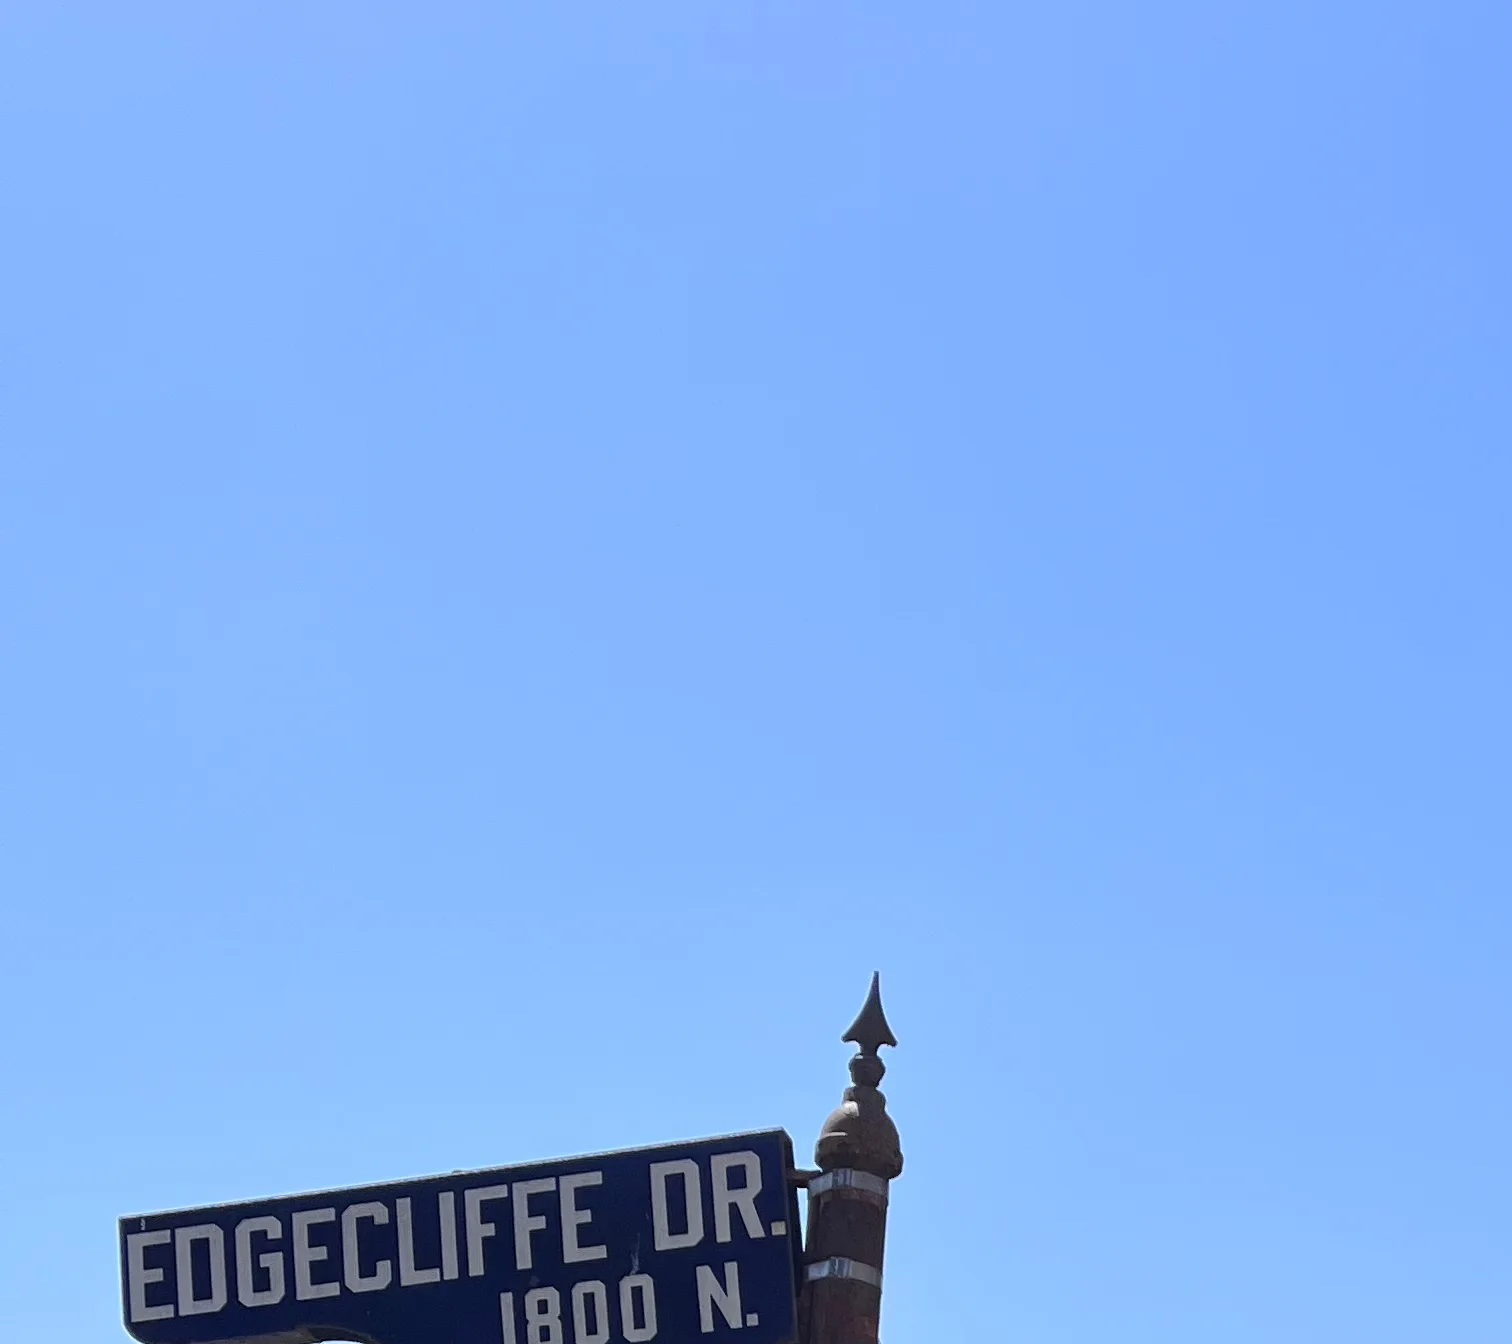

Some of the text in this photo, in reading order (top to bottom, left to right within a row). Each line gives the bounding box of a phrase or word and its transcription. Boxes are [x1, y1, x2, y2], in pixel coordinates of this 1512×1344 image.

[126, 1149, 787, 1323] EDGECLIFFE DR.
[695, 1260, 760, 1334] N.
